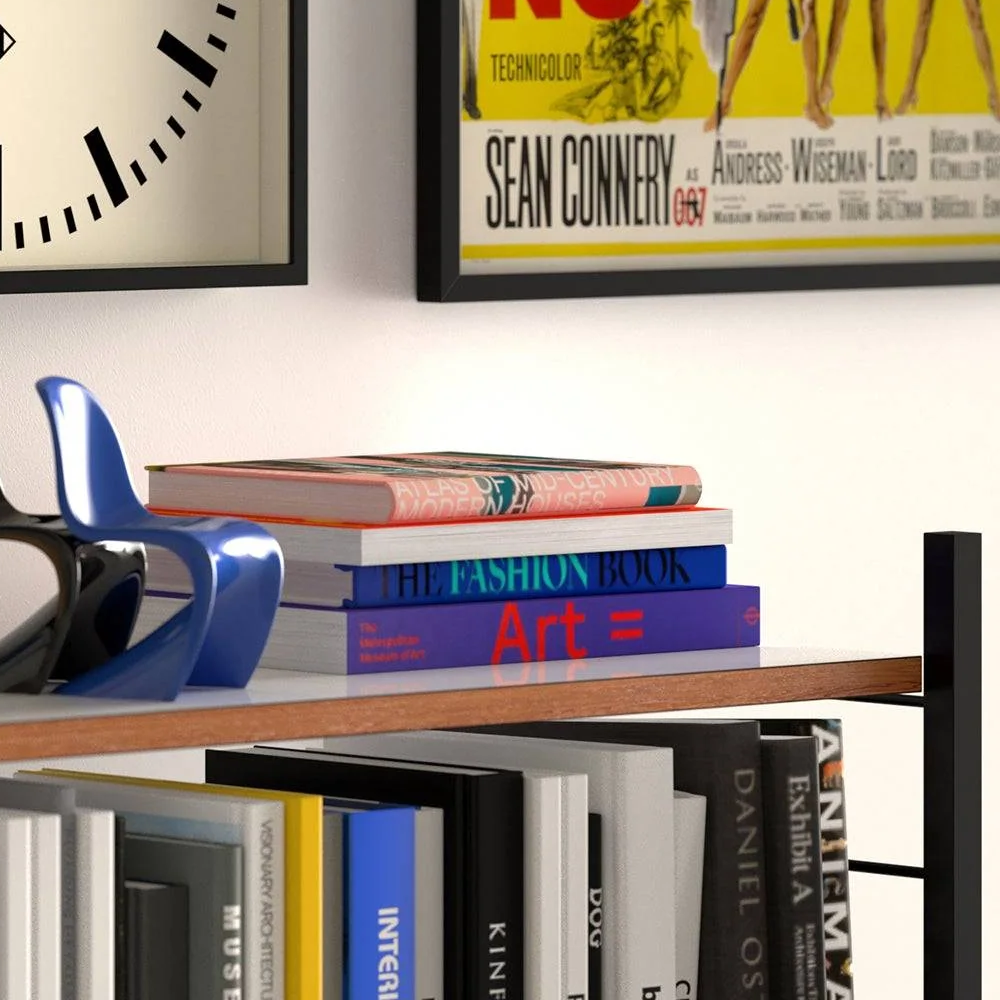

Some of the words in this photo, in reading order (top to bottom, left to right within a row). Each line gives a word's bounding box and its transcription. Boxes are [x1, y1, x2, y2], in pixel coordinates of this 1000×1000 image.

[491, 53, 582, 83] TECHNICOLOR
[486, 135, 552, 229] SEAN
[562, 134, 675, 228] CONNERY
[711, 139, 783, 185] ANDRESS
[791, 137, 867, 182] WISEMAN
[877, 135, 918, 182] LORD
[396, 477, 467, 498] ATLAS
[473, 474, 506, 494] OF
[514, 466, 675, 492] MID-CENTURY
[399, 496, 503, 519] MODERN
[511, 490, 606, 515] HOUSES
[381, 562, 444, 599] THE
[450, 553, 589, 595] FASHION
[599, 547, 691, 588] BOOK
[491, 601, 588, 665] Art
[734, 769, 761, 916] DANIEL
[788, 774, 813, 874] Exhibit
[260, 820, 274, 899] VISIONARY
[590, 888, 602, 948] DOG
[793, 881, 814, 904] A
[223, 905, 241, 1000] MUSE
